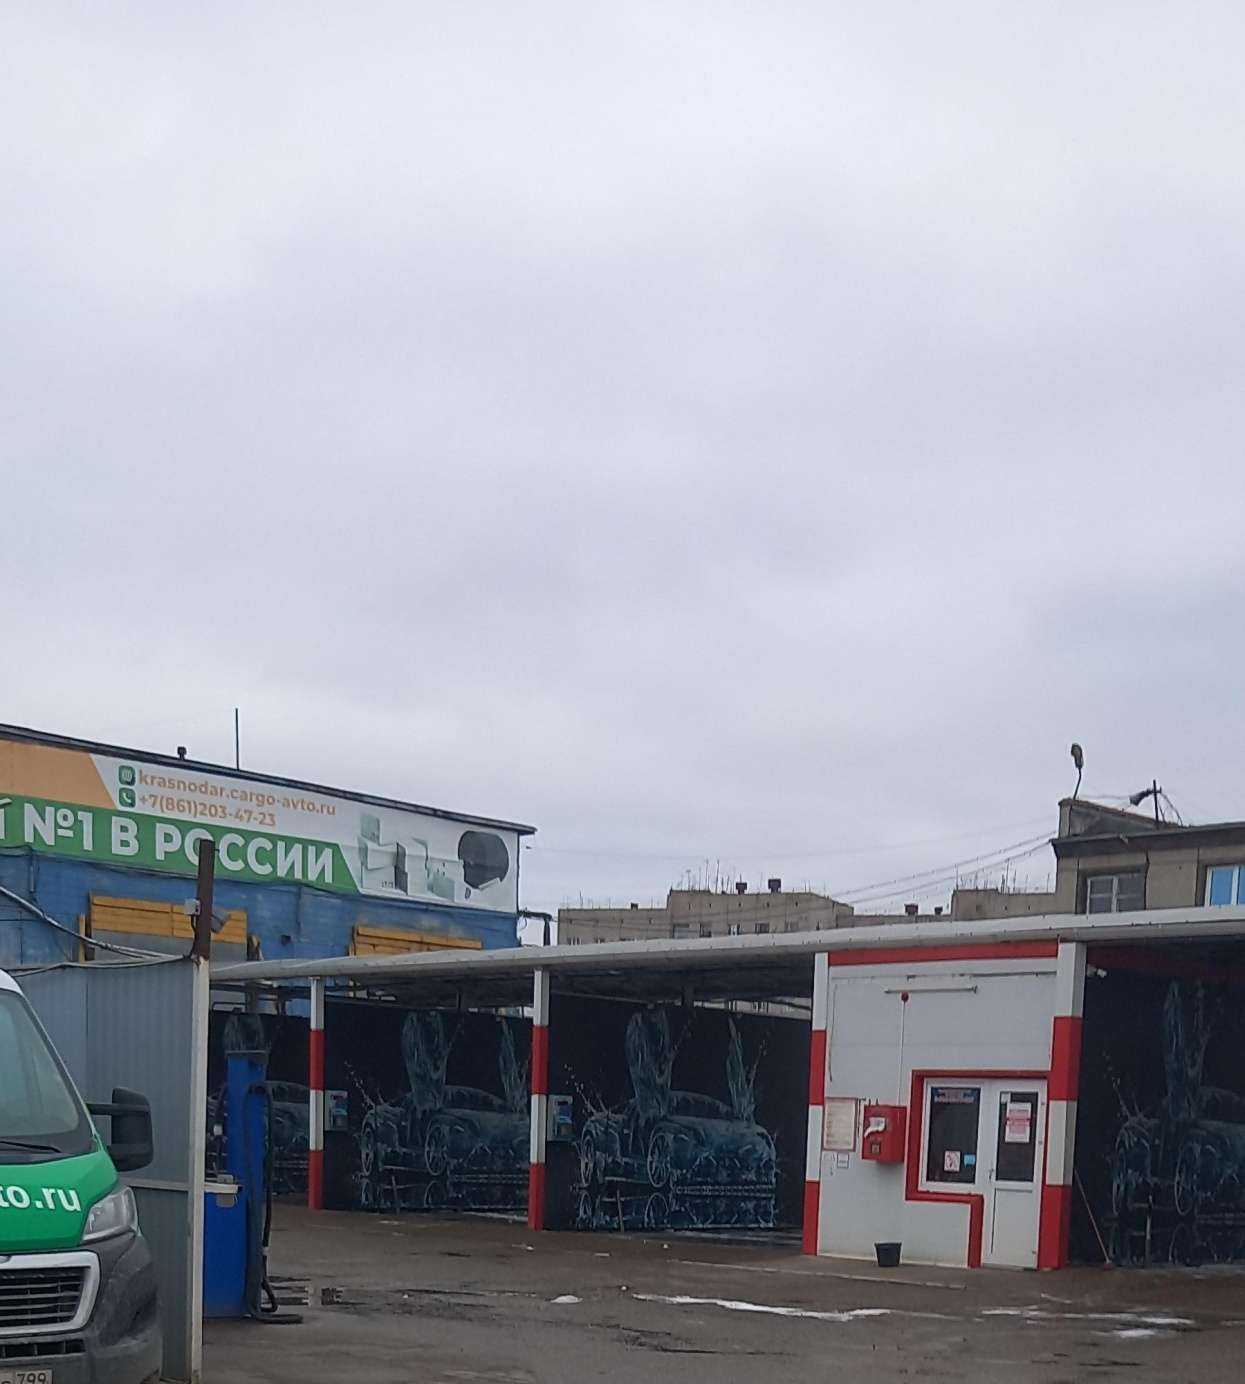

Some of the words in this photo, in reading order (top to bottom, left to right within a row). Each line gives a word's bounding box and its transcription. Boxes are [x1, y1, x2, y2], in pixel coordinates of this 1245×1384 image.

[139, 769, 336, 816] krasnodar.cargo-avto.ru
[140, 793, 276, 827] +7(861)203-47-23
[24, 803, 93, 850] №1
[111, 816, 139, 856] В
[155, 823, 333, 883] РОССИИ
